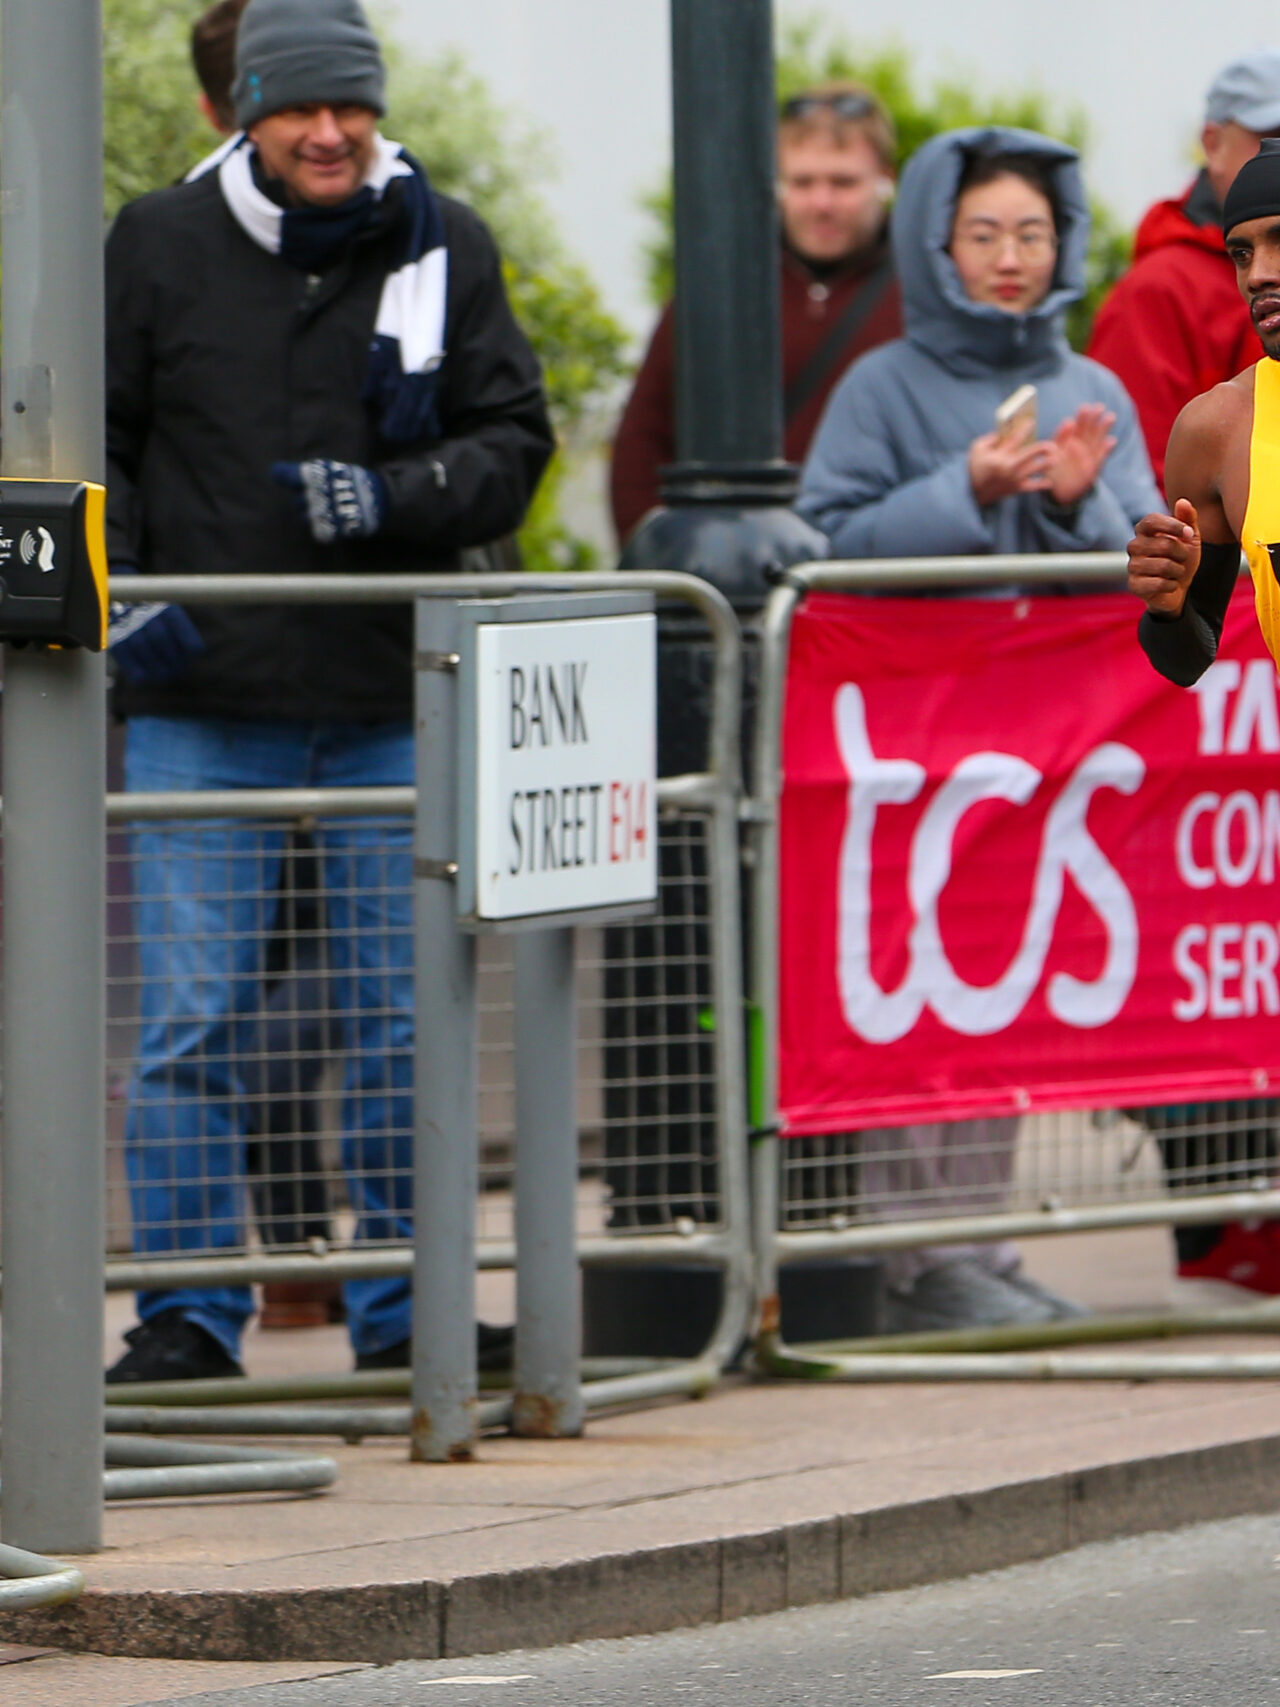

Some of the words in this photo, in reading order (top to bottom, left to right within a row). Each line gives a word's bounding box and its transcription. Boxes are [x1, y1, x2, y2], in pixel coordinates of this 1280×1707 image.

[510, 661, 588, 750] BANK
[508, 783, 603, 876] STREET
[607, 780, 648, 864] E14
[833, 681, 1147, 1045] tcs
